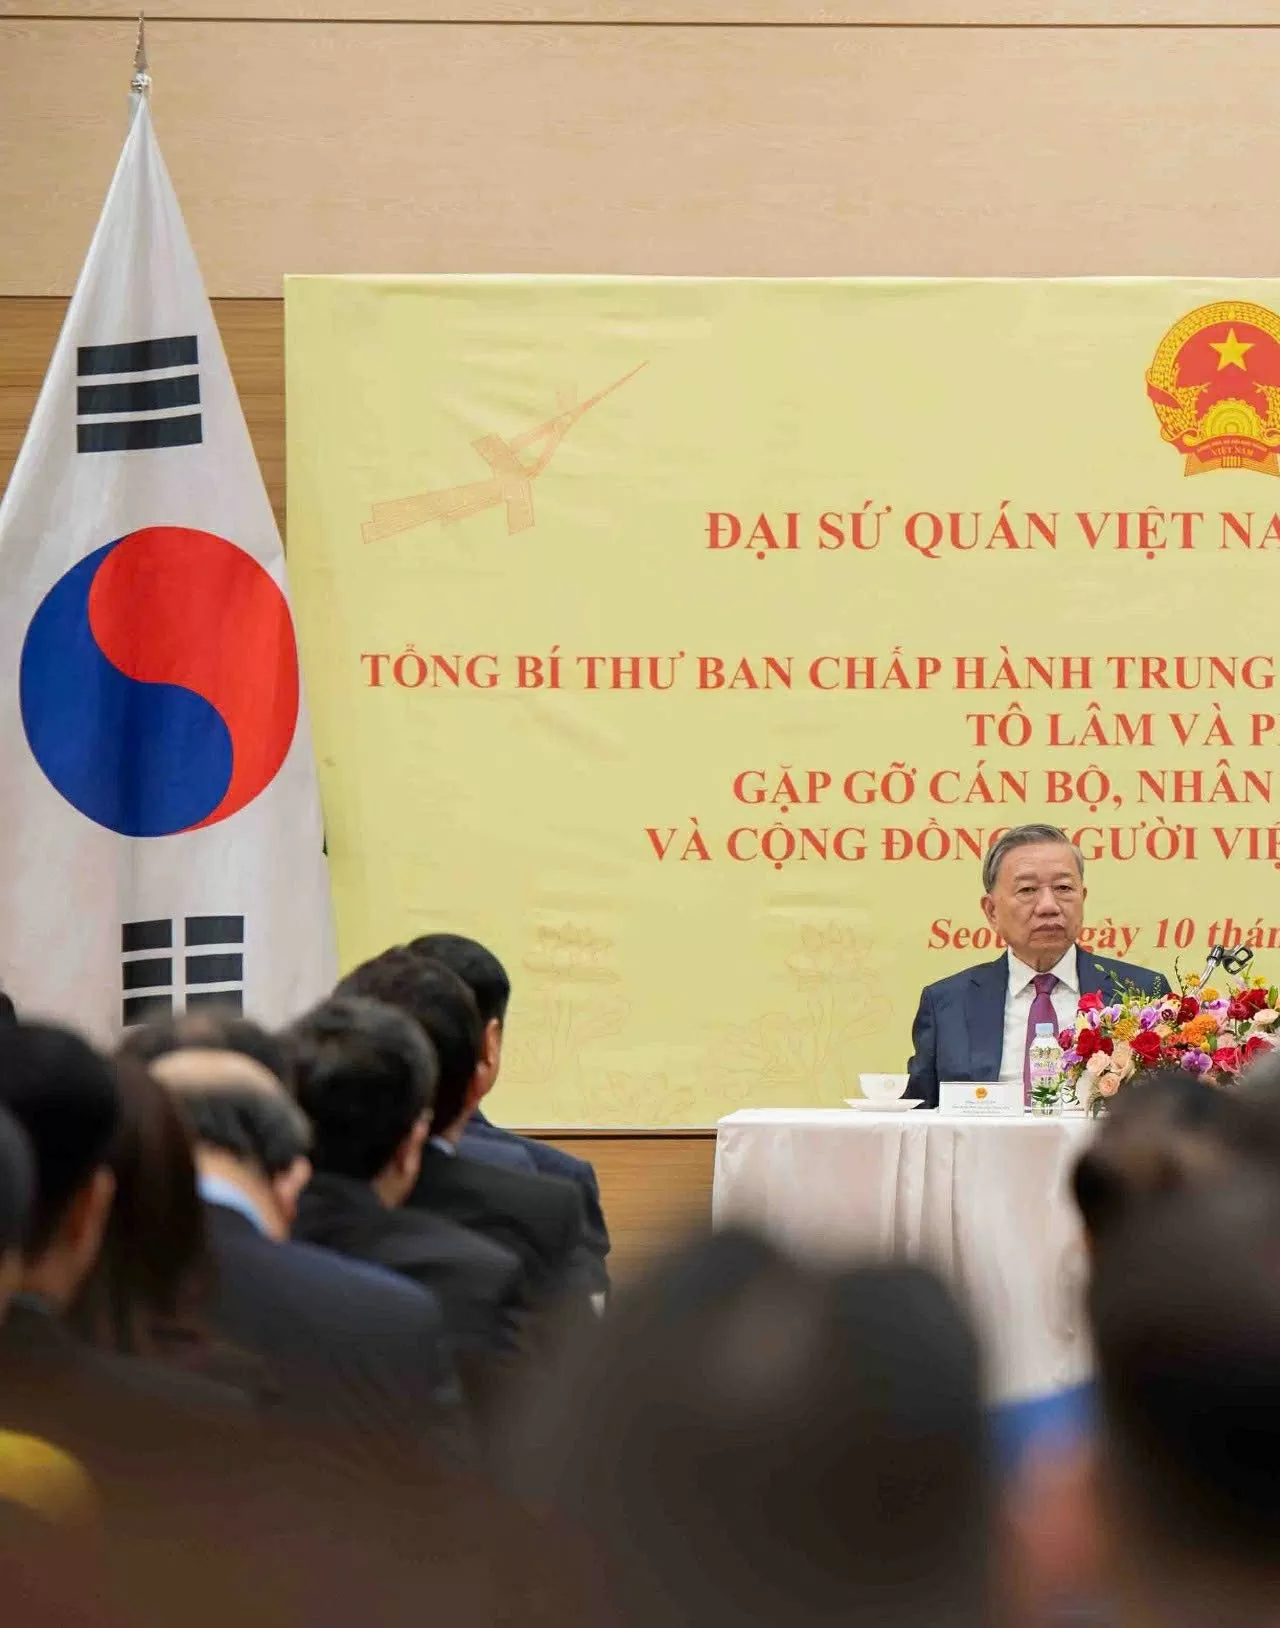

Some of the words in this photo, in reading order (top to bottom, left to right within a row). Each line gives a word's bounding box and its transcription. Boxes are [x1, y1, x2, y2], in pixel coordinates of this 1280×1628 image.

[705, 511, 801, 560] ĐẠI
[817, 500, 893, 551] SỨ
[903, 500, 1060, 559] QUÁN
[1075, 505, 1205, 560] VIỆT
[360, 643, 501, 690] TỔNG
[515, 645, 562, 690] BÍ
[574, 650, 686, 690] THƯ
[696, 655, 794, 691] BAN
[807, 645, 943, 691] CHẤP
[952, 645, 1094, 691] HÀNH
[1105, 655, 1276, 691] TRUNG
[966, 702, 1033, 748] TÔ
[1046, 702, 1154, 748] LÂM
[1168, 703, 1236, 748] VÀ
[731, 764, 833, 813] GẶP
[842, 761, 918, 804] GỠ
[928, 760, 1029, 804] CÁN
[1044, 764, 1124, 813] BỘ,
[1136, 759, 1274, 804] NHÂN
[644, 817, 713, 861] VÀ
[726, 822, 868, 870] CỘNG
[880, 817, 1007, 861] ĐỒN
[1059, 816, 1201, 861] GƯỜI
[927, 918, 1005, 949] Seo
[1077, 918, 1141, 957] gày
[1153, 917, 1197, 949] 10
